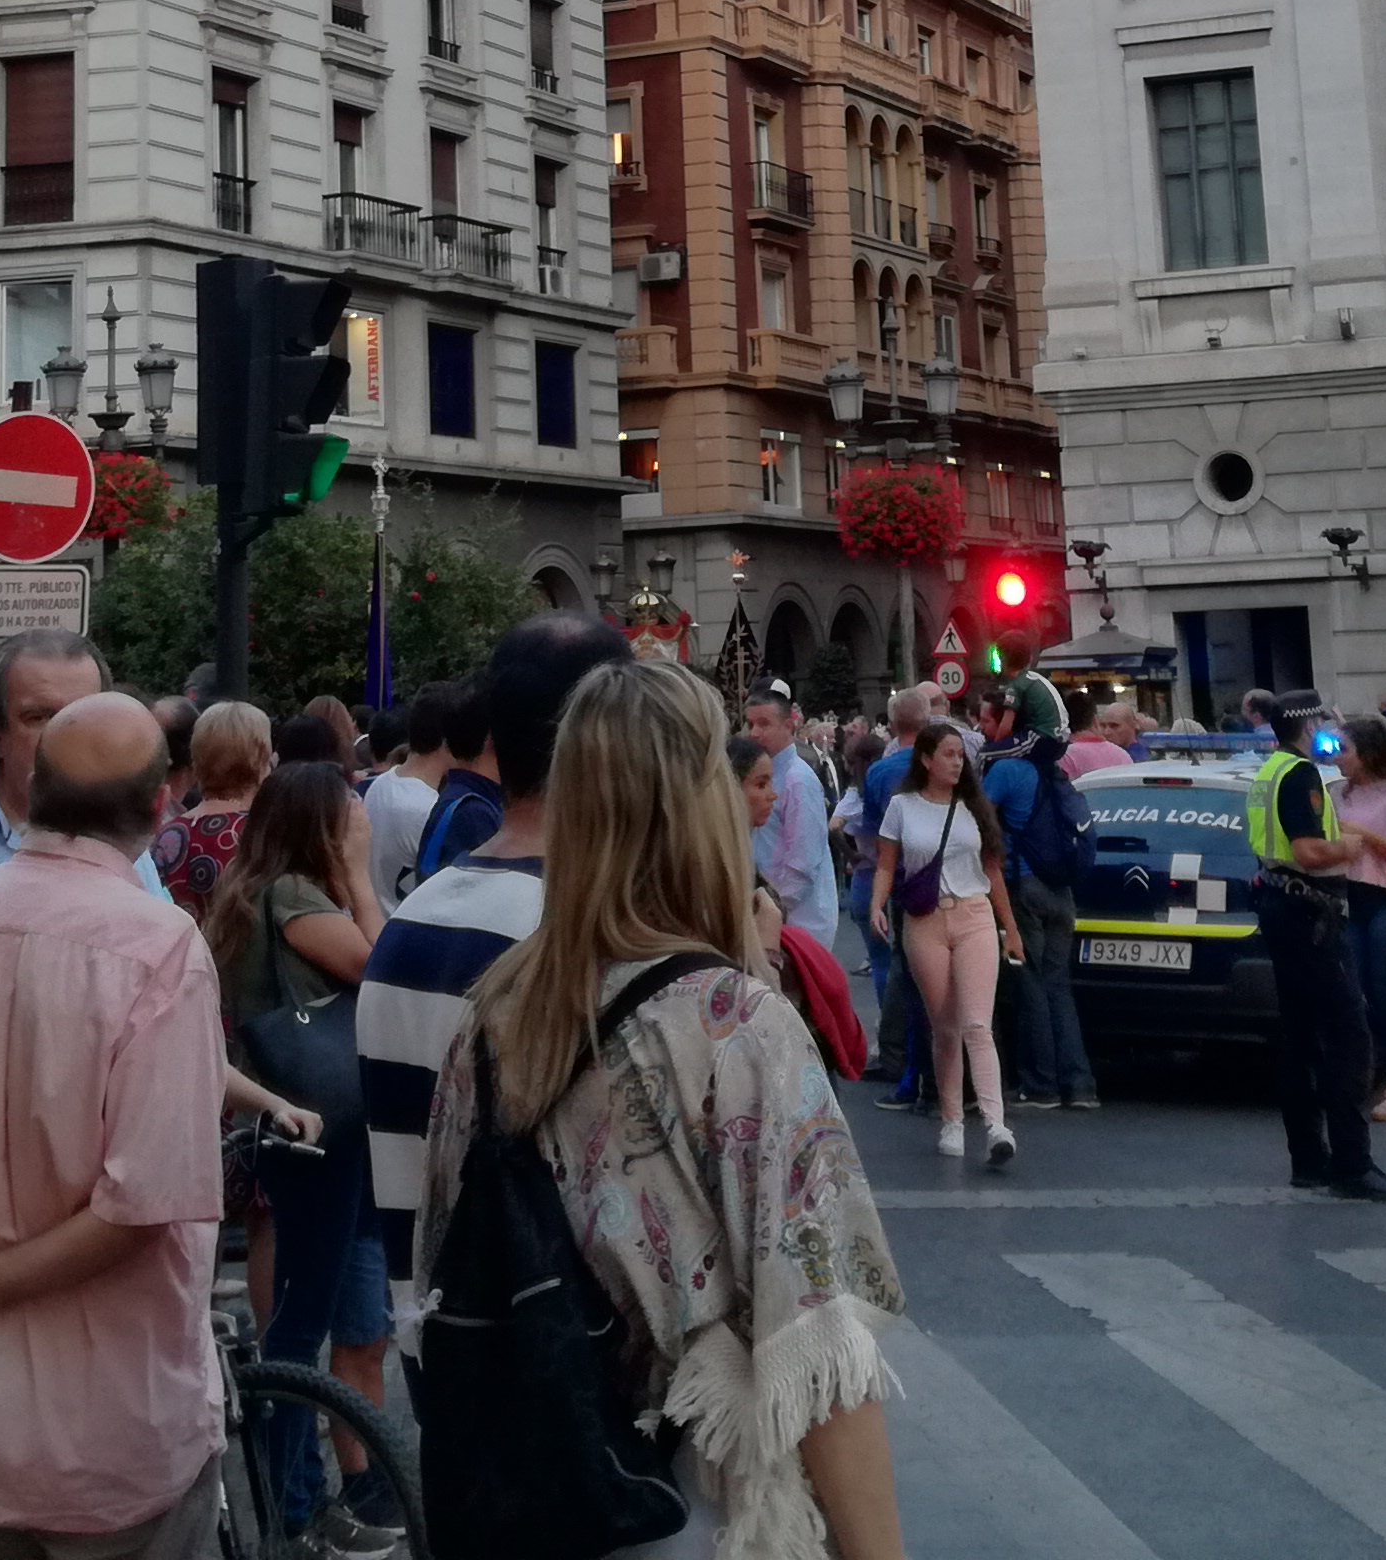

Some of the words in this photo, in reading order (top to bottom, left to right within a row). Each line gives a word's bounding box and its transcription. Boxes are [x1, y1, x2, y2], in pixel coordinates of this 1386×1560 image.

[29, 579, 72, 593] PÚBLICO
[73, 581, 80, 593] Y
[12, 598, 80, 611] AUTORIZADOS
[6, 616, 13, 627] H
[15, 616, 22, 627] A
[941, 670, 961, 685] 30
[1091, 806, 1160, 822] OLICÍA
[1165, 809, 1244, 831] LOCAL
[1093, 942, 1141, 962] 9349
[1148, 942, 1187, 965] JXX
